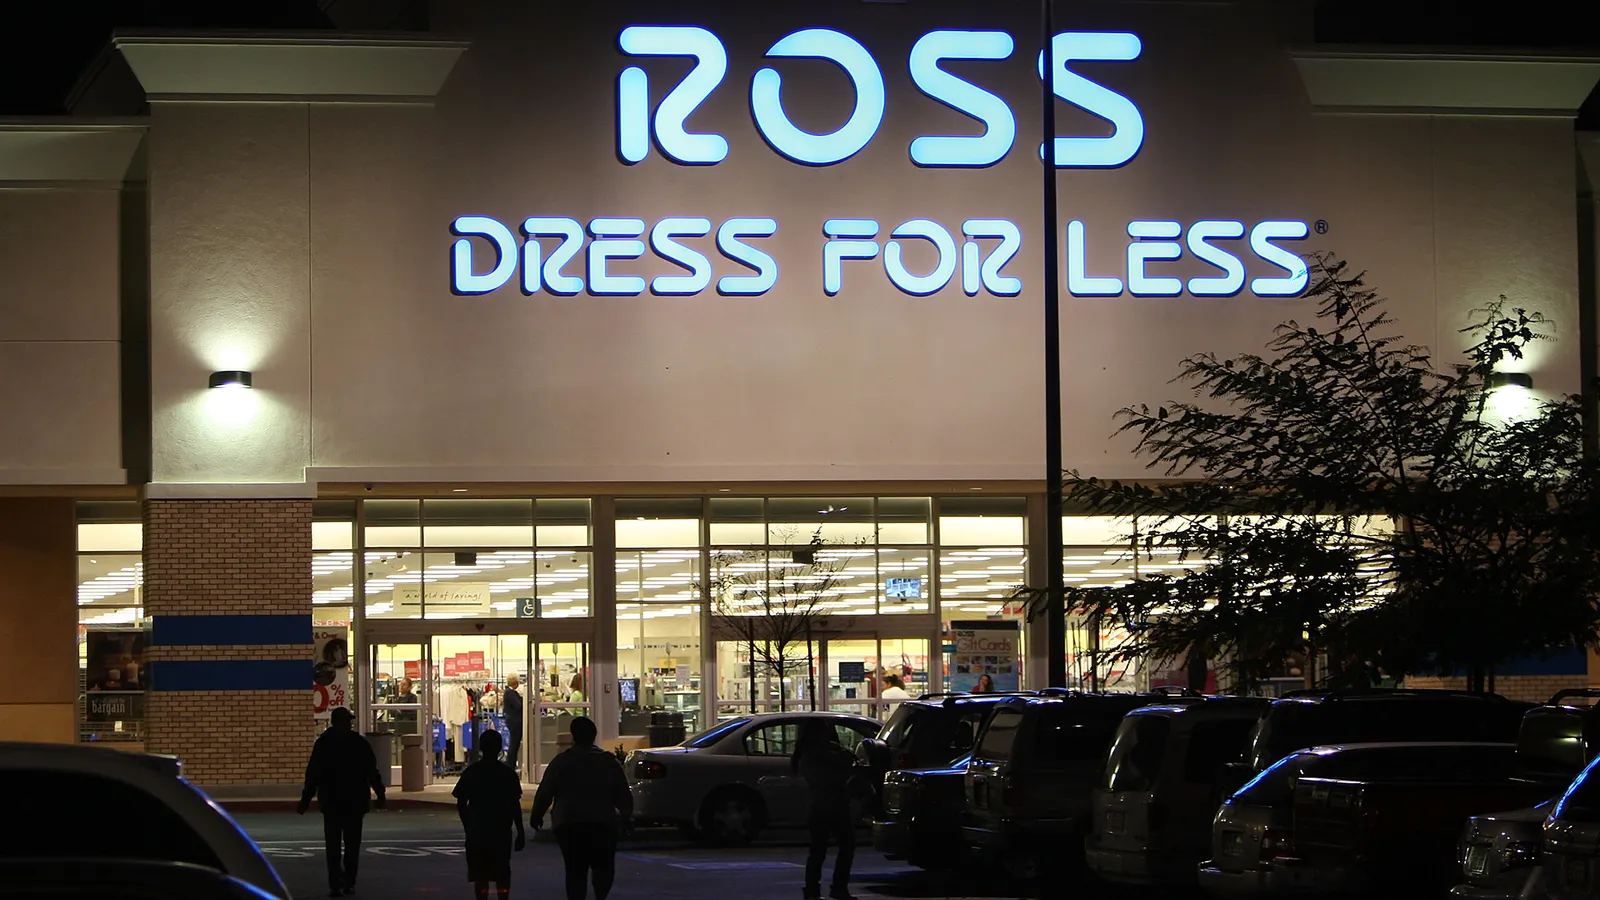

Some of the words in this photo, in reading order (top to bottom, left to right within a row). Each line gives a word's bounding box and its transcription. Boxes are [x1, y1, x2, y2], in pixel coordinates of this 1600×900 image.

[617, 25, 1145, 168] ROSS
[450, 215, 778, 296] DRESS
[823, 218, 1021, 297] FOR
[1067, 219, 1311, 297] LESS
[91, 699, 126, 716] bargain
[329, 696, 345, 706] off
